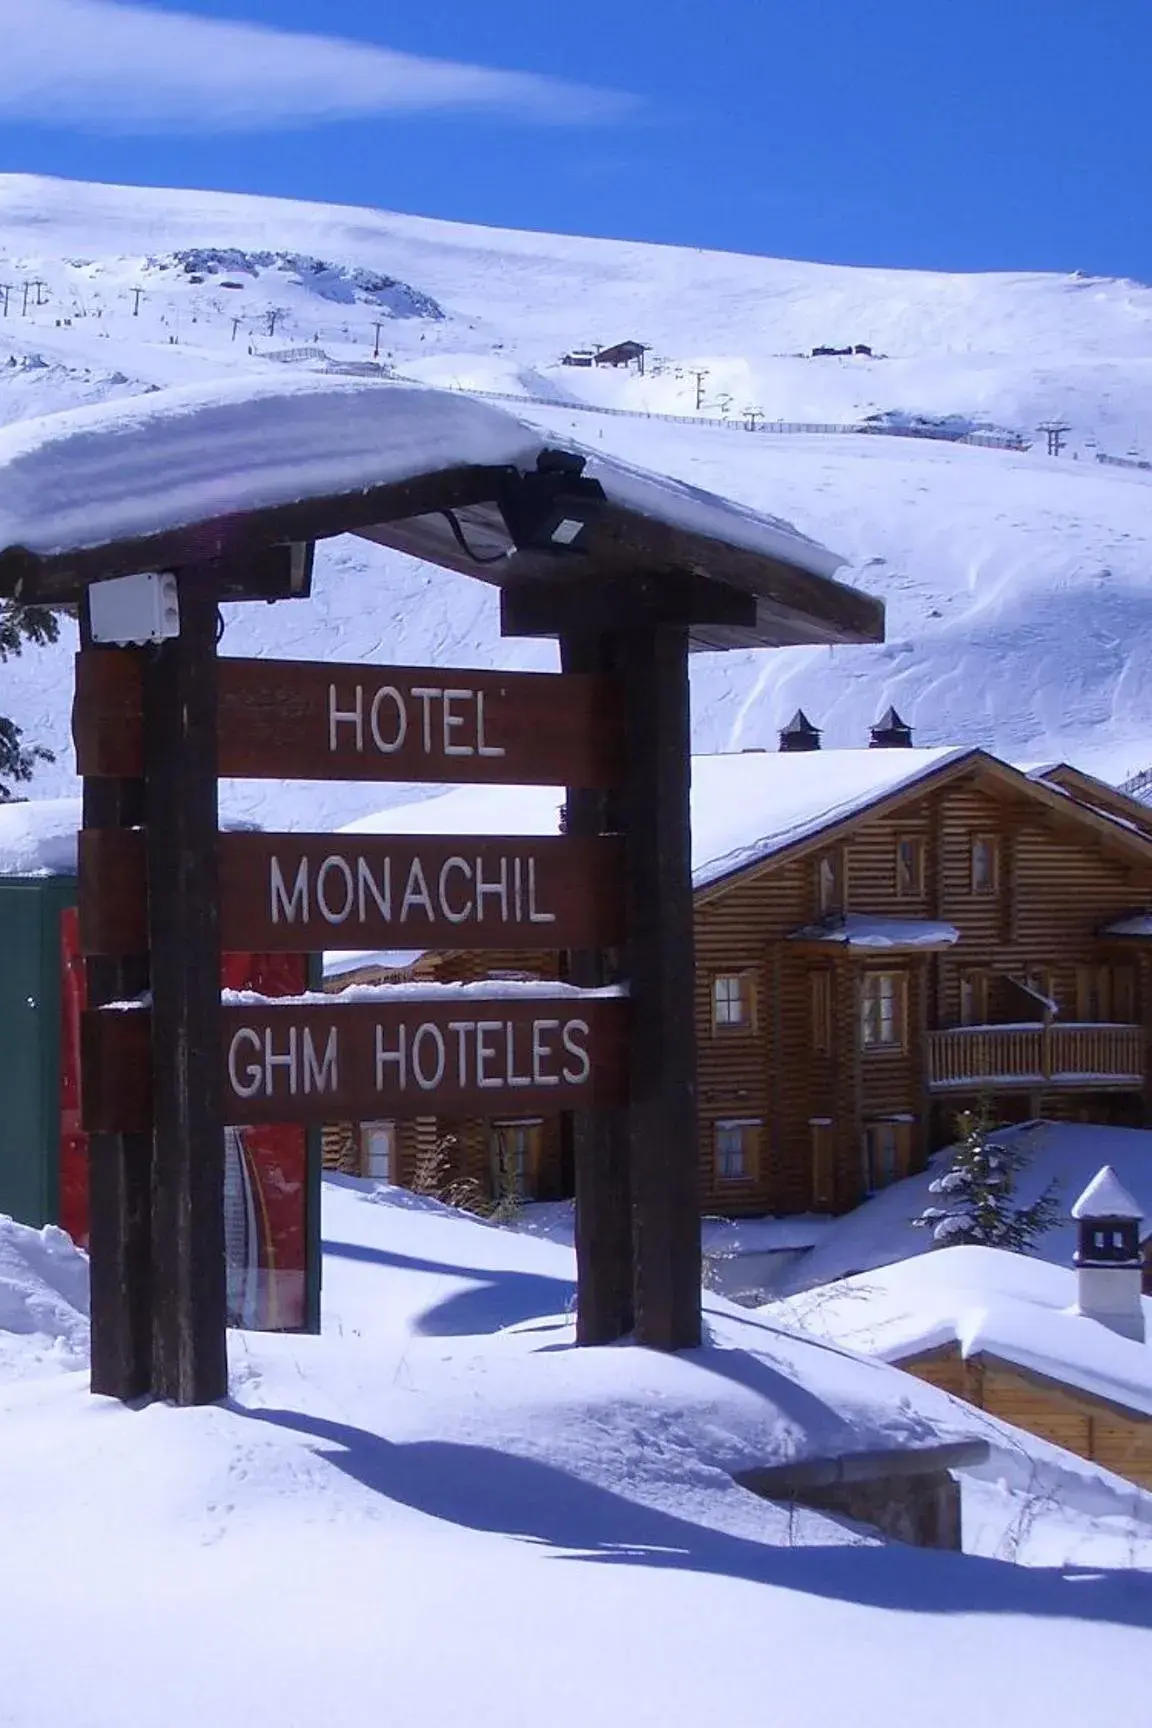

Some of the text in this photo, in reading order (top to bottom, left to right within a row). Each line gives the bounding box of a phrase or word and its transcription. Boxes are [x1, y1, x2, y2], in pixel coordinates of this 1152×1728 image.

[329, 683, 506, 756] HOTEL
[270, 855, 555, 924] MONACHIL
[228, 1018, 590, 1098] GHM HOTELES
